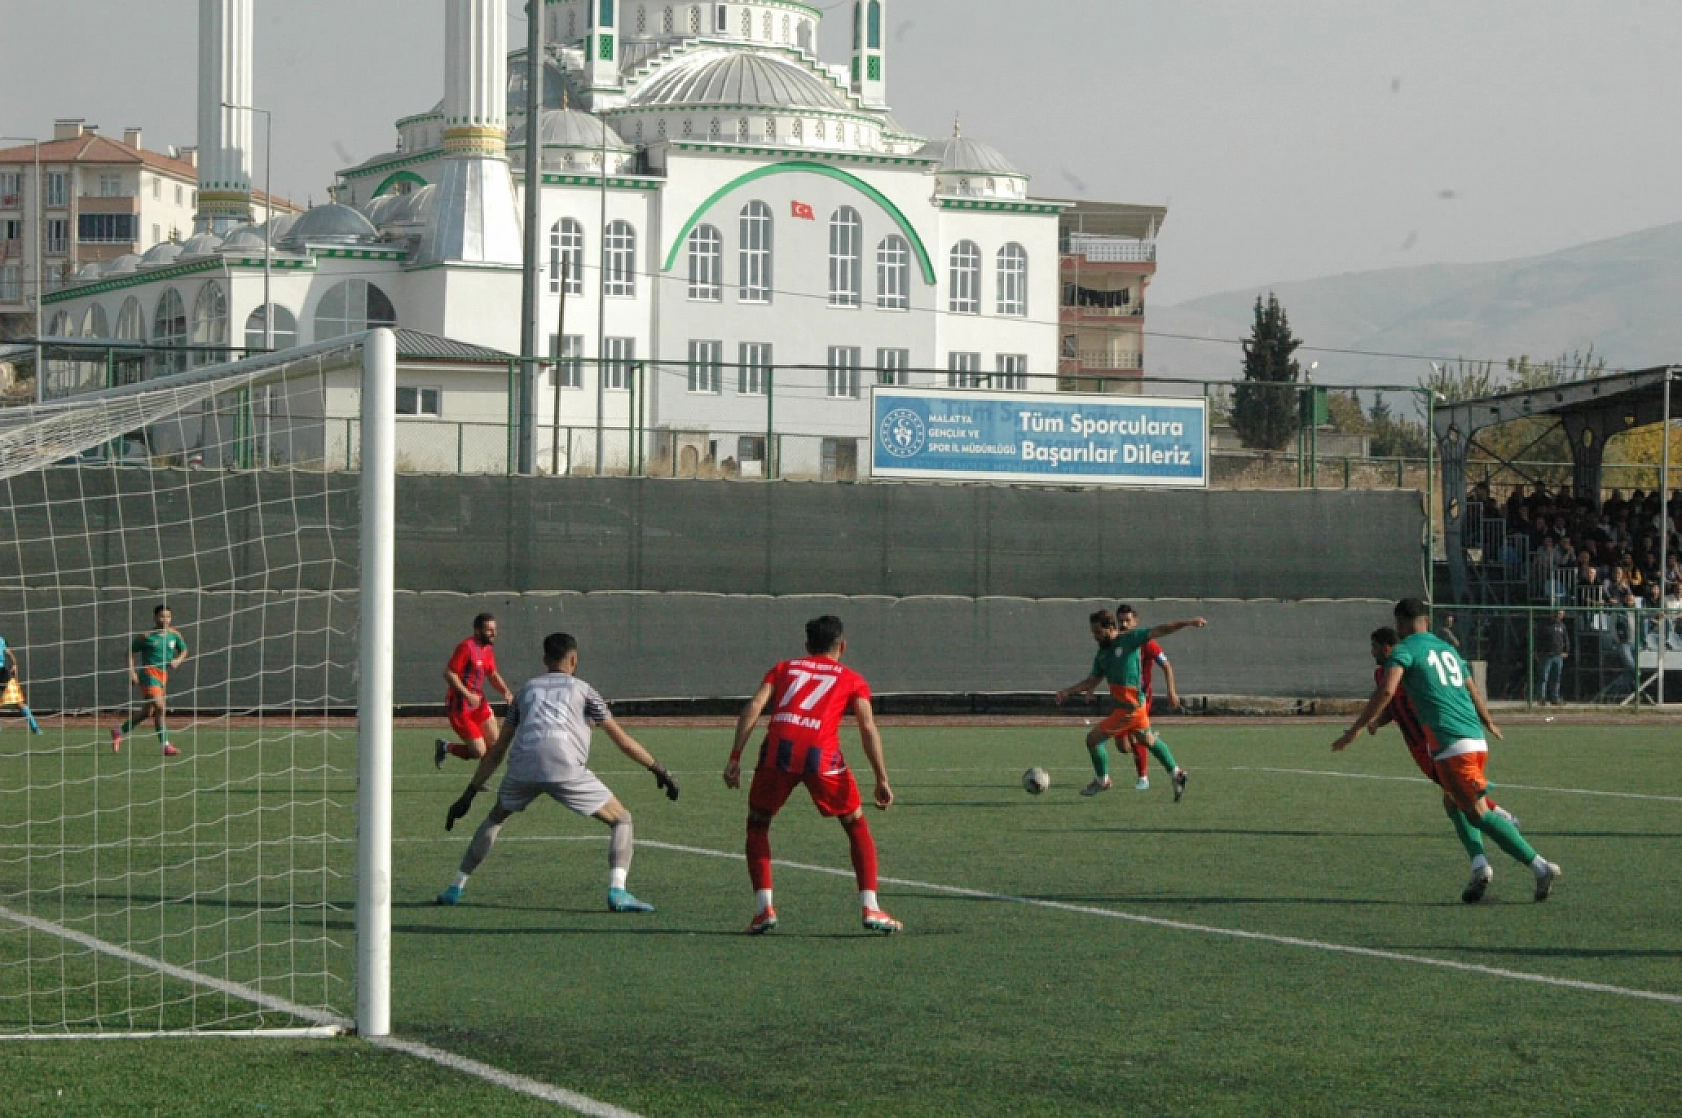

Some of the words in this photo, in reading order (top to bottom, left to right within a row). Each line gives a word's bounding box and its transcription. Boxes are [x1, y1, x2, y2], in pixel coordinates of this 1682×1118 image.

[928, 413, 972, 424] MALATYA
[1019, 411, 1064, 433] Tüm
[1070, 413, 1183, 438] Sporculara
[928, 442, 950, 453] SPOR
[968, 429, 980, 439] VE
[1021, 439, 1119, 467] Başarılar
[1122, 444, 1191, 465] Dileriz
[1427, 649, 1463, 687] 19
[779, 669, 838, 710] 77
